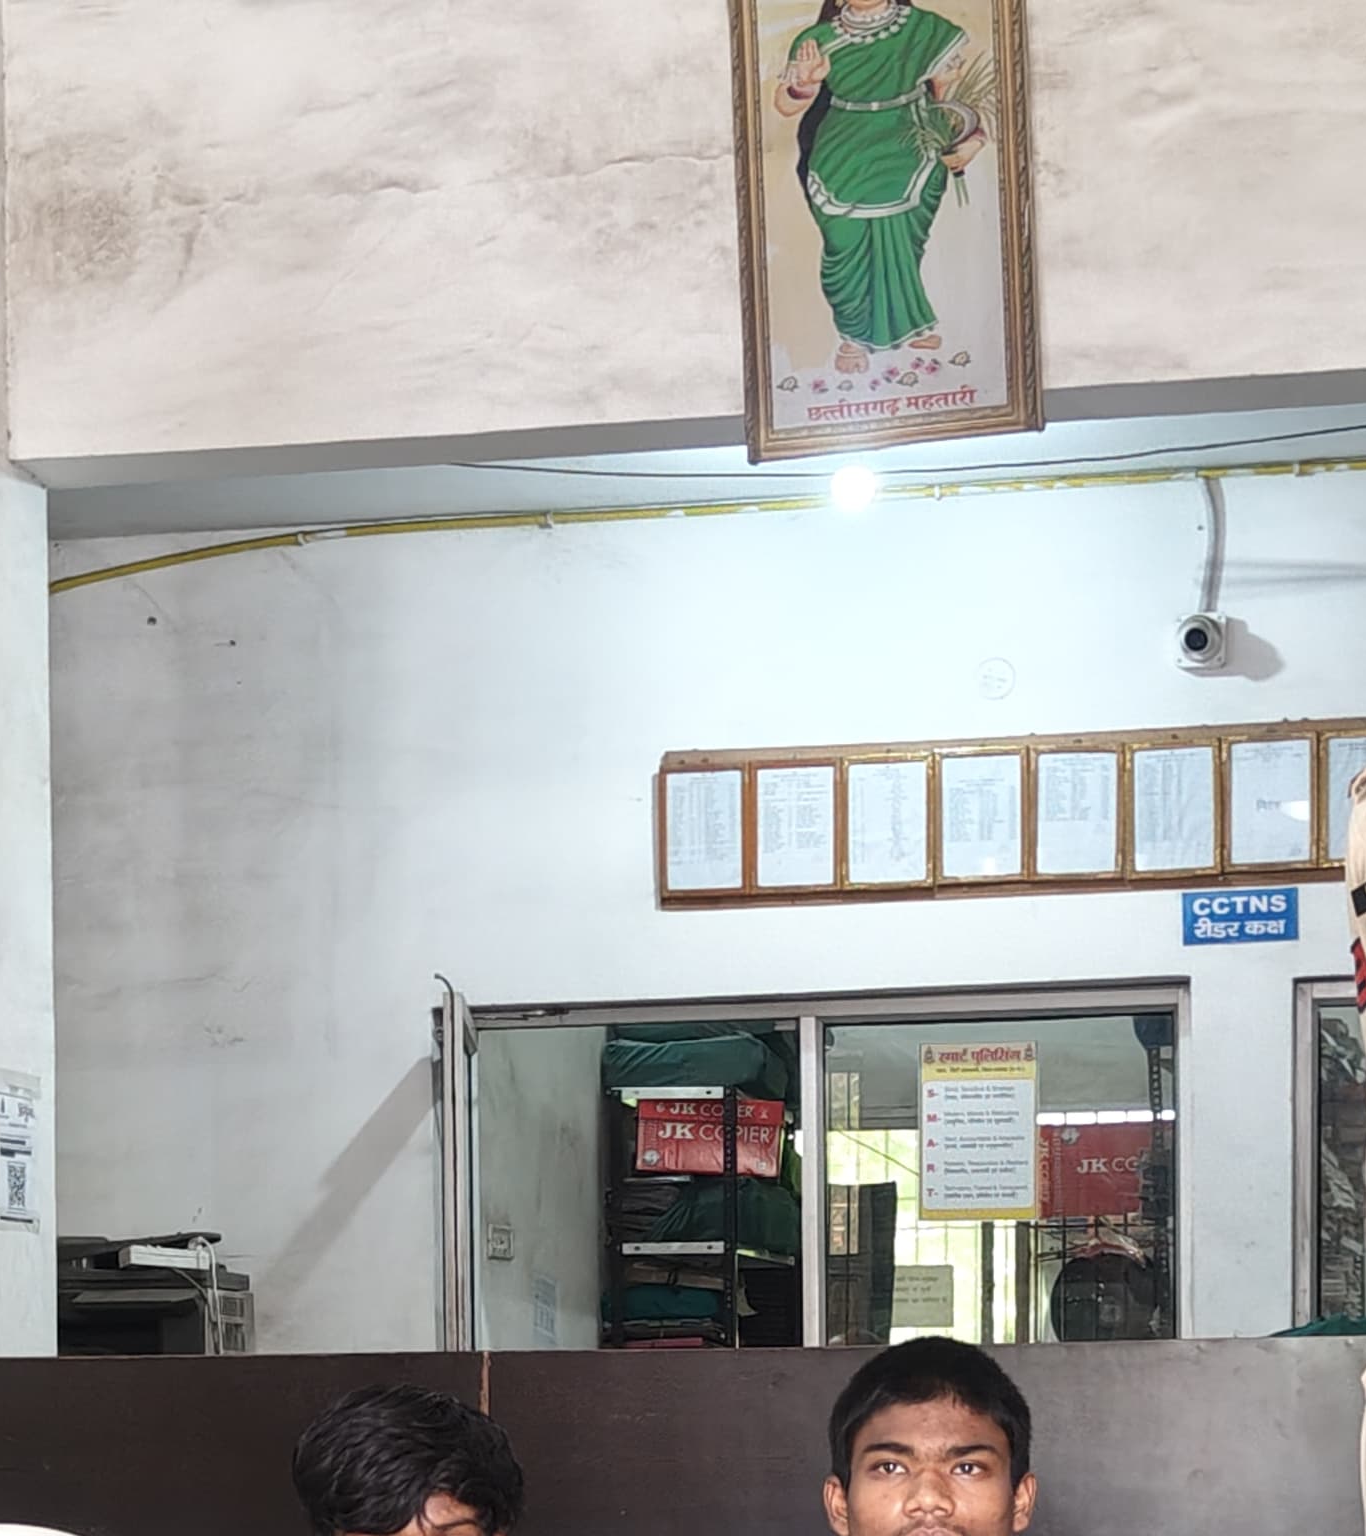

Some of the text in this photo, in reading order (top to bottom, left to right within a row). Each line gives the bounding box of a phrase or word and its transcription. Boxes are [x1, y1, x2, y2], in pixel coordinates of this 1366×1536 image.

[906, 384, 978, 411] महतारी
[1192, 894, 1287, 916] CCTNS
[669, 1102, 696, 1115] JK
[658, 1122, 695, 1140] JK
[1077, 1158, 1108, 1174] JK
